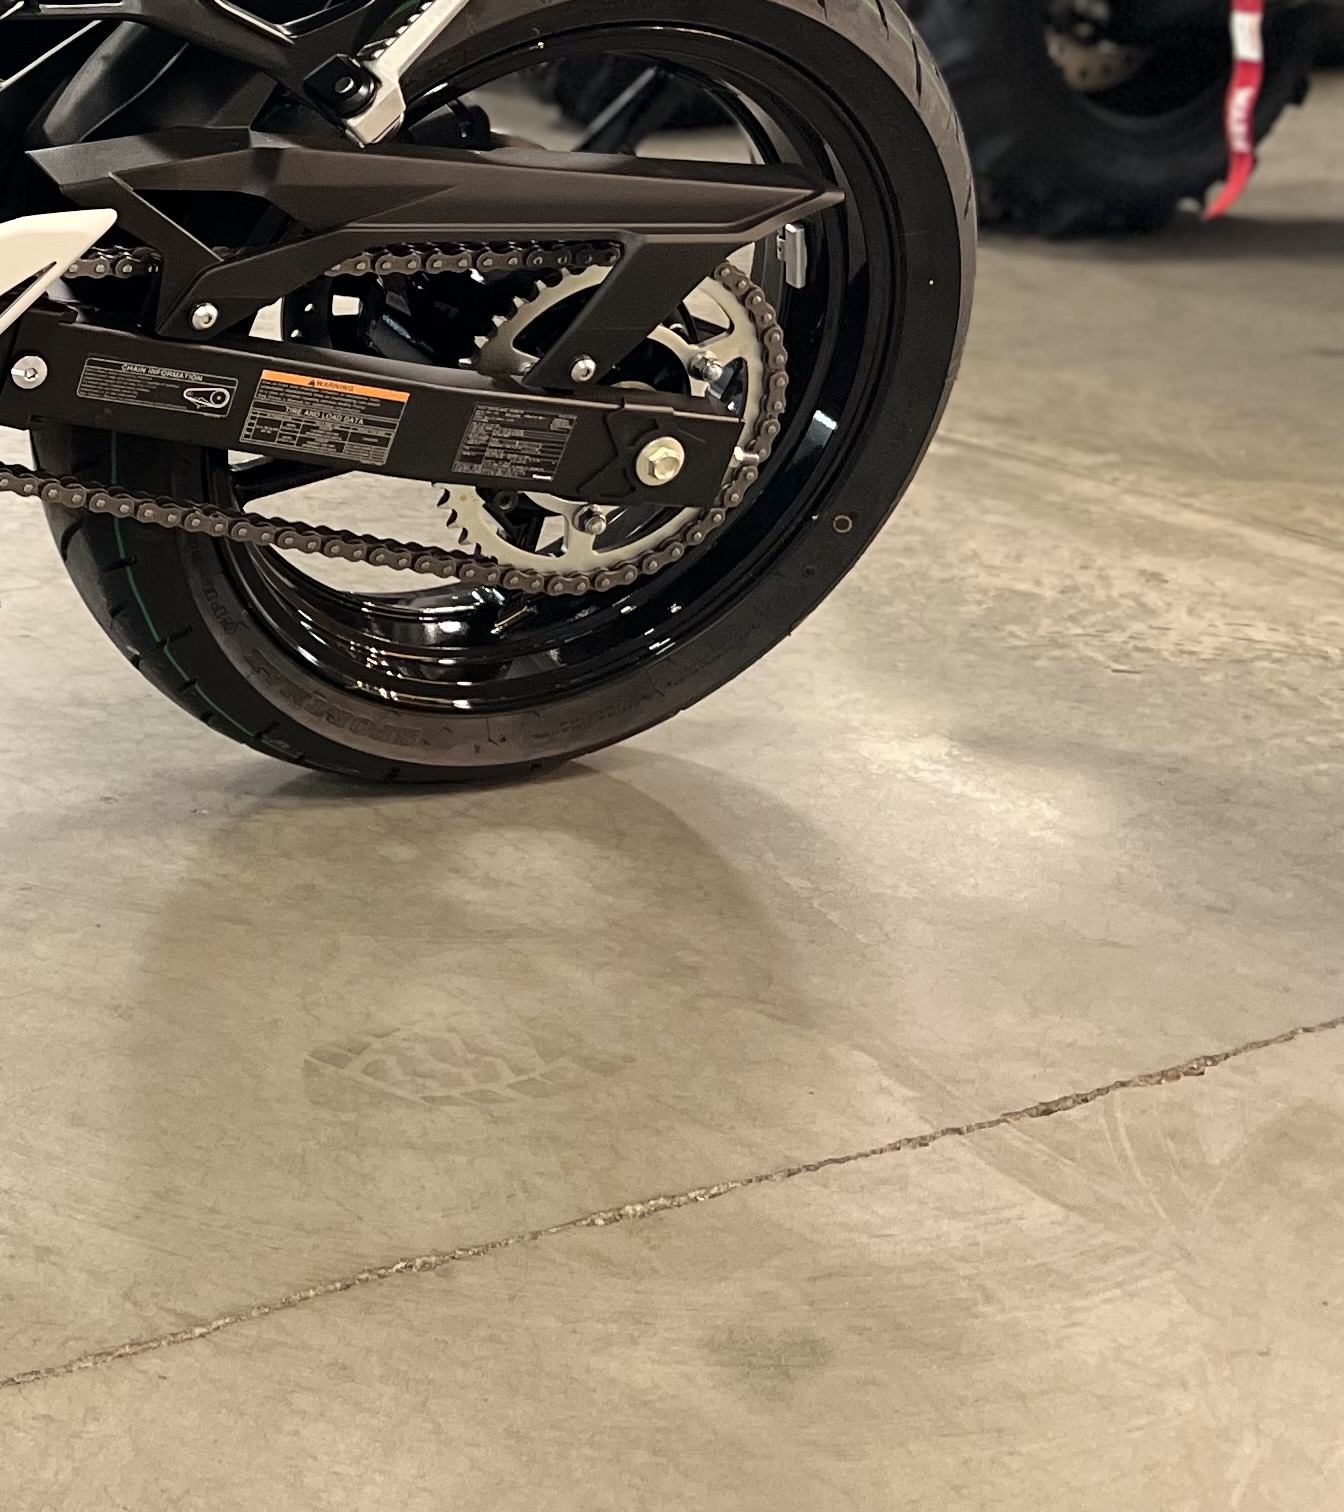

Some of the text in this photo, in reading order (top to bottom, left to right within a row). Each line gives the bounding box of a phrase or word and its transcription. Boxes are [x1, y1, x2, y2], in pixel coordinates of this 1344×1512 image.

[121, 363, 204, 382] CHAIN INFORMATION
[316, 379, 355, 393] WARNING
[304, 409, 321, 419] AND
[322, 412, 343, 423] LOAD
[343, 416, 365, 426] DATA
